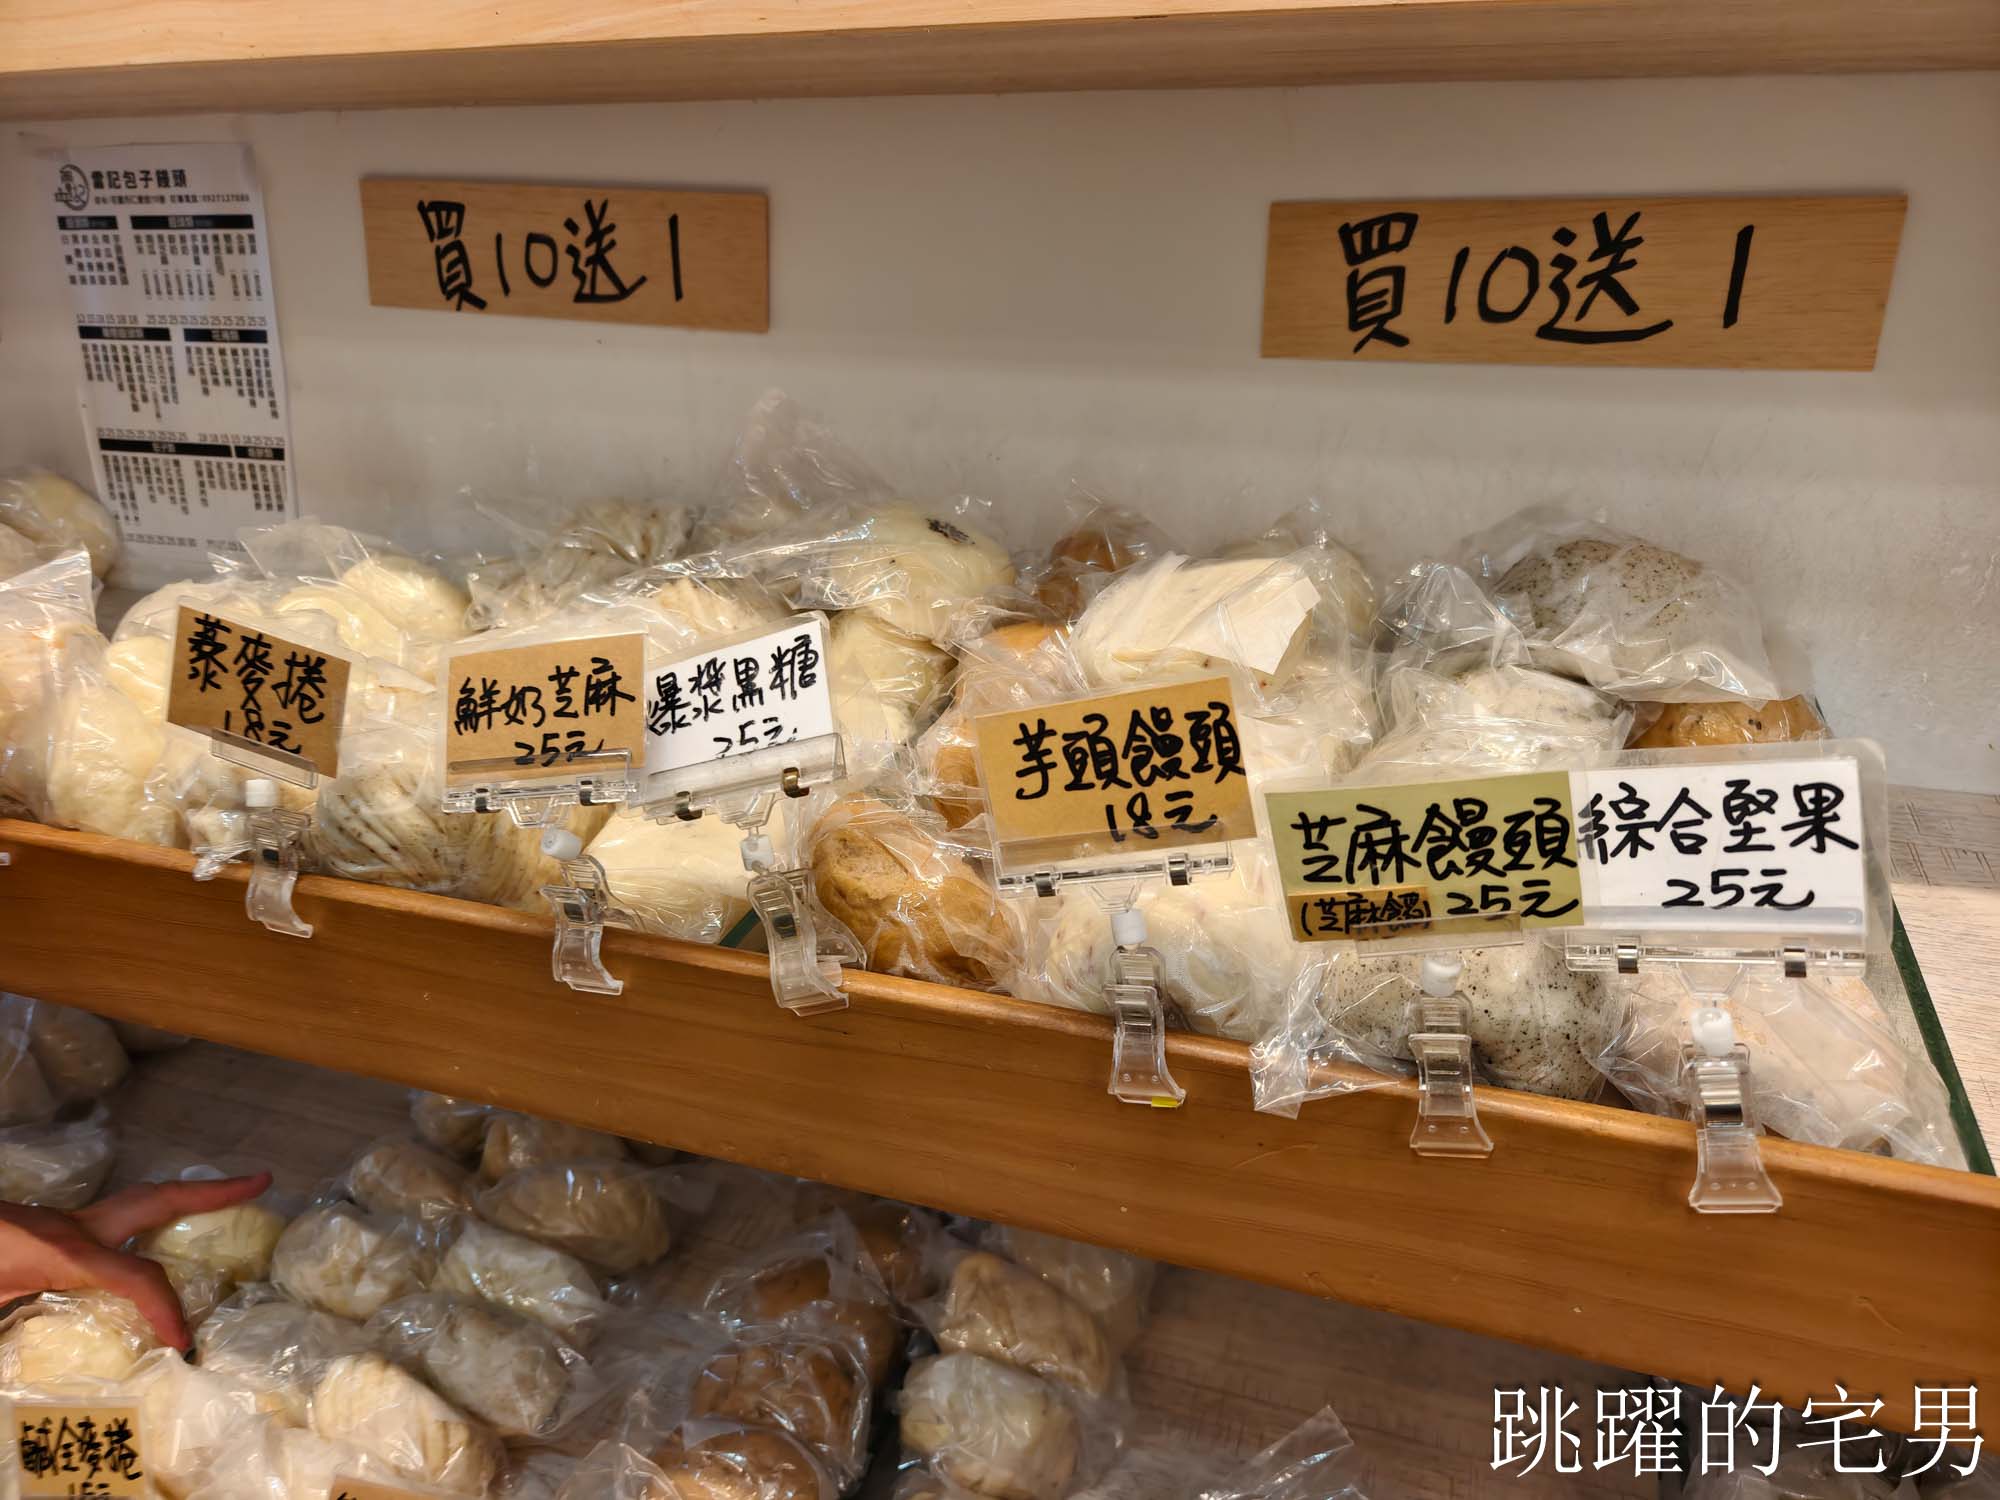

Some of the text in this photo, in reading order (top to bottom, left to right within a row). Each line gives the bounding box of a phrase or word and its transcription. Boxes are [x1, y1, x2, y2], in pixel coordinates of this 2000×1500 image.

[417, 200, 684, 311] 買10送1
[1338, 211, 1755, 353] 買10送1
[454, 657, 636, 736] 鮮奶芝麻
[647, 634, 820, 736] 爆漿黑糖
[514, 730, 605, 767] 25元
[1013, 701, 1246, 800] 芋頭饅頭
[1105, 791, 1218, 843] 18元
[1292, 798, 1578, 885] 芝麻饅頭
[1577, 779, 1860, 864] 綜合堅果
[1446, 879, 1580, 919] 25元
[1661, 869, 1816, 911] 25元
